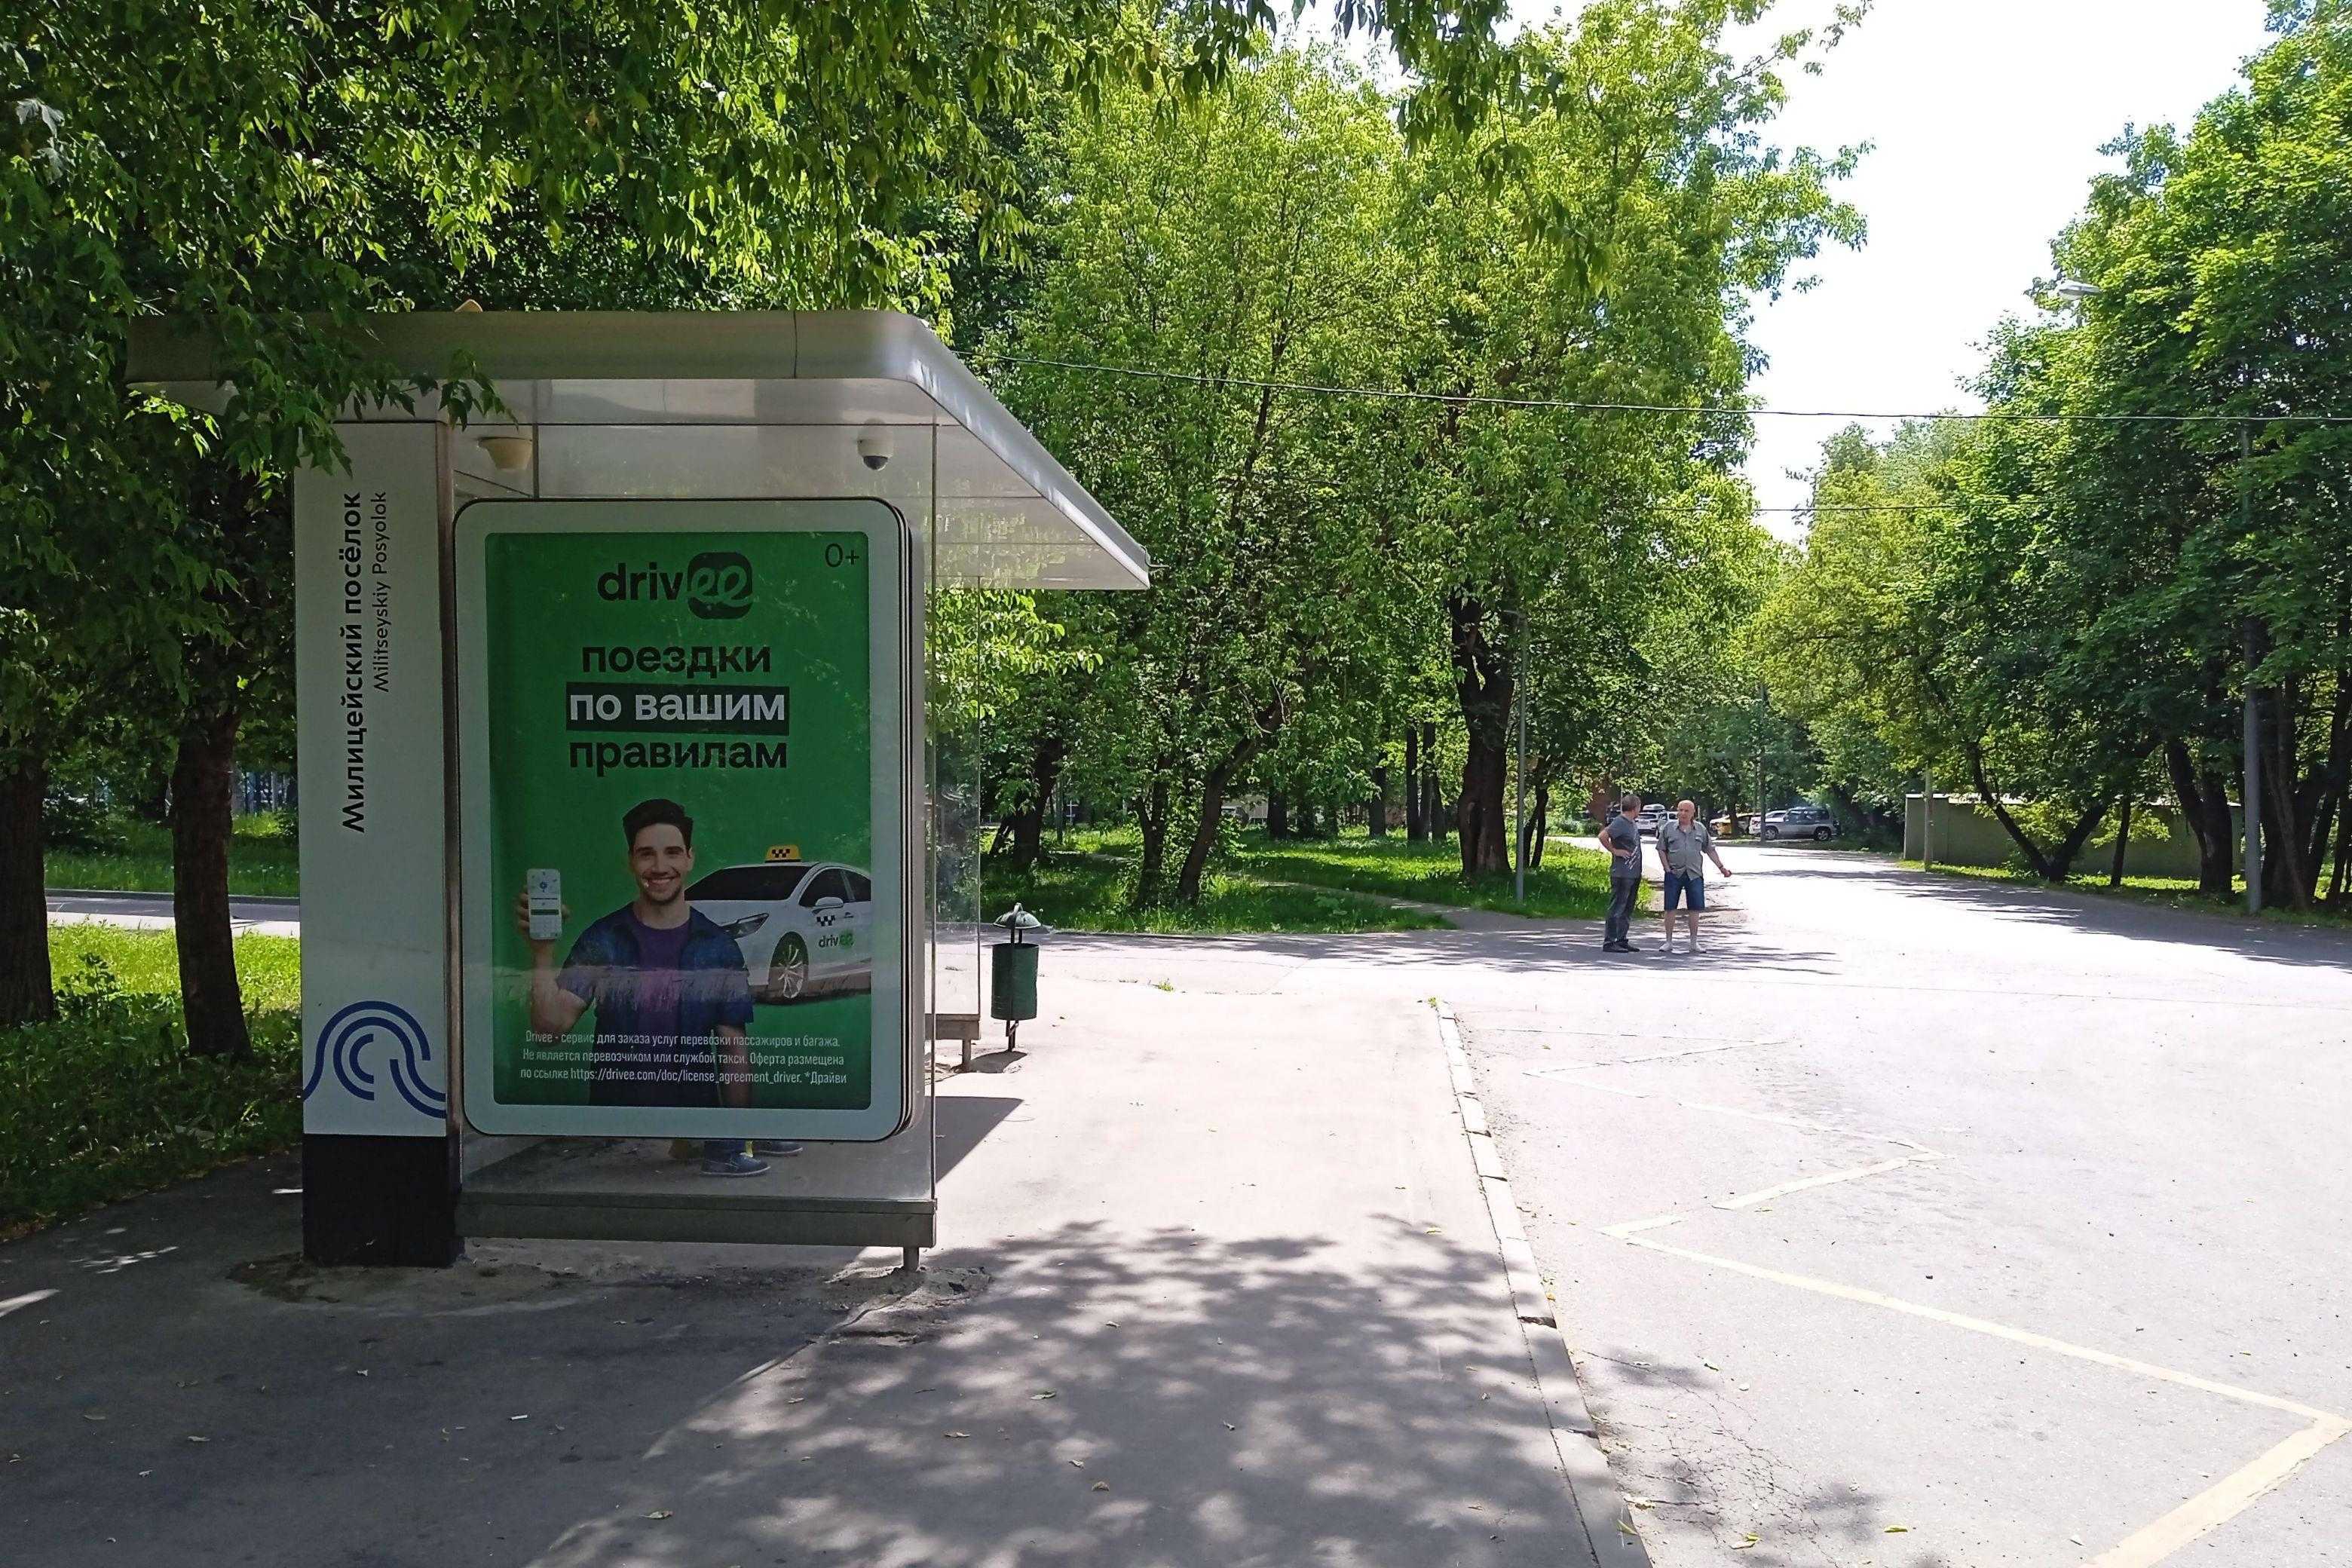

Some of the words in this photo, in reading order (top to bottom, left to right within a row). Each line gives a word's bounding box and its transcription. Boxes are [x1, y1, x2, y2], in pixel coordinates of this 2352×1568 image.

[370, 491, 390, 574] Posyolok
[338, 492, 363, 614] посёлок
[824, 542, 860, 568] 0+
[596, 551, 754, 620] drivee
[372, 581, 392, 693] Militseyskiy
[581, 645, 772, 679] поездки
[570, 694, 622, 721] по
[635, 694, 786, 721] вашим
[340, 624, 367, 834] Милицейский
[569, 740, 788, 777] правилам
[522, 1049, 535, 1061] Не
[536, 1051, 581, 1061] является
[583, 1052, 651, 1064] перевозчиком
[653, 1053, 672, 1063] или
[673, 1052, 716, 1065] службой
[718, 1054, 748, 1064] такси.
[749, 1052, 786, 1067] Оферта
[788, 1055, 845, 1067] размещена
[561, 1034, 595, 1045] сервис
[596, 1034, 617, 1045] для
[617, 1034, 651, 1045] заказа
[652, 1034, 679, 1047] услуг
[681, 1035, 731, 1047] перевозки
[733, 1036, 793, 1048] пассажиров
[795, 1037, 801, 1046] и
[803, 1034, 841, 1047] багажа.
[519, 1069, 532, 1079] по
[534, 1069, 569, 1080] ссылке
